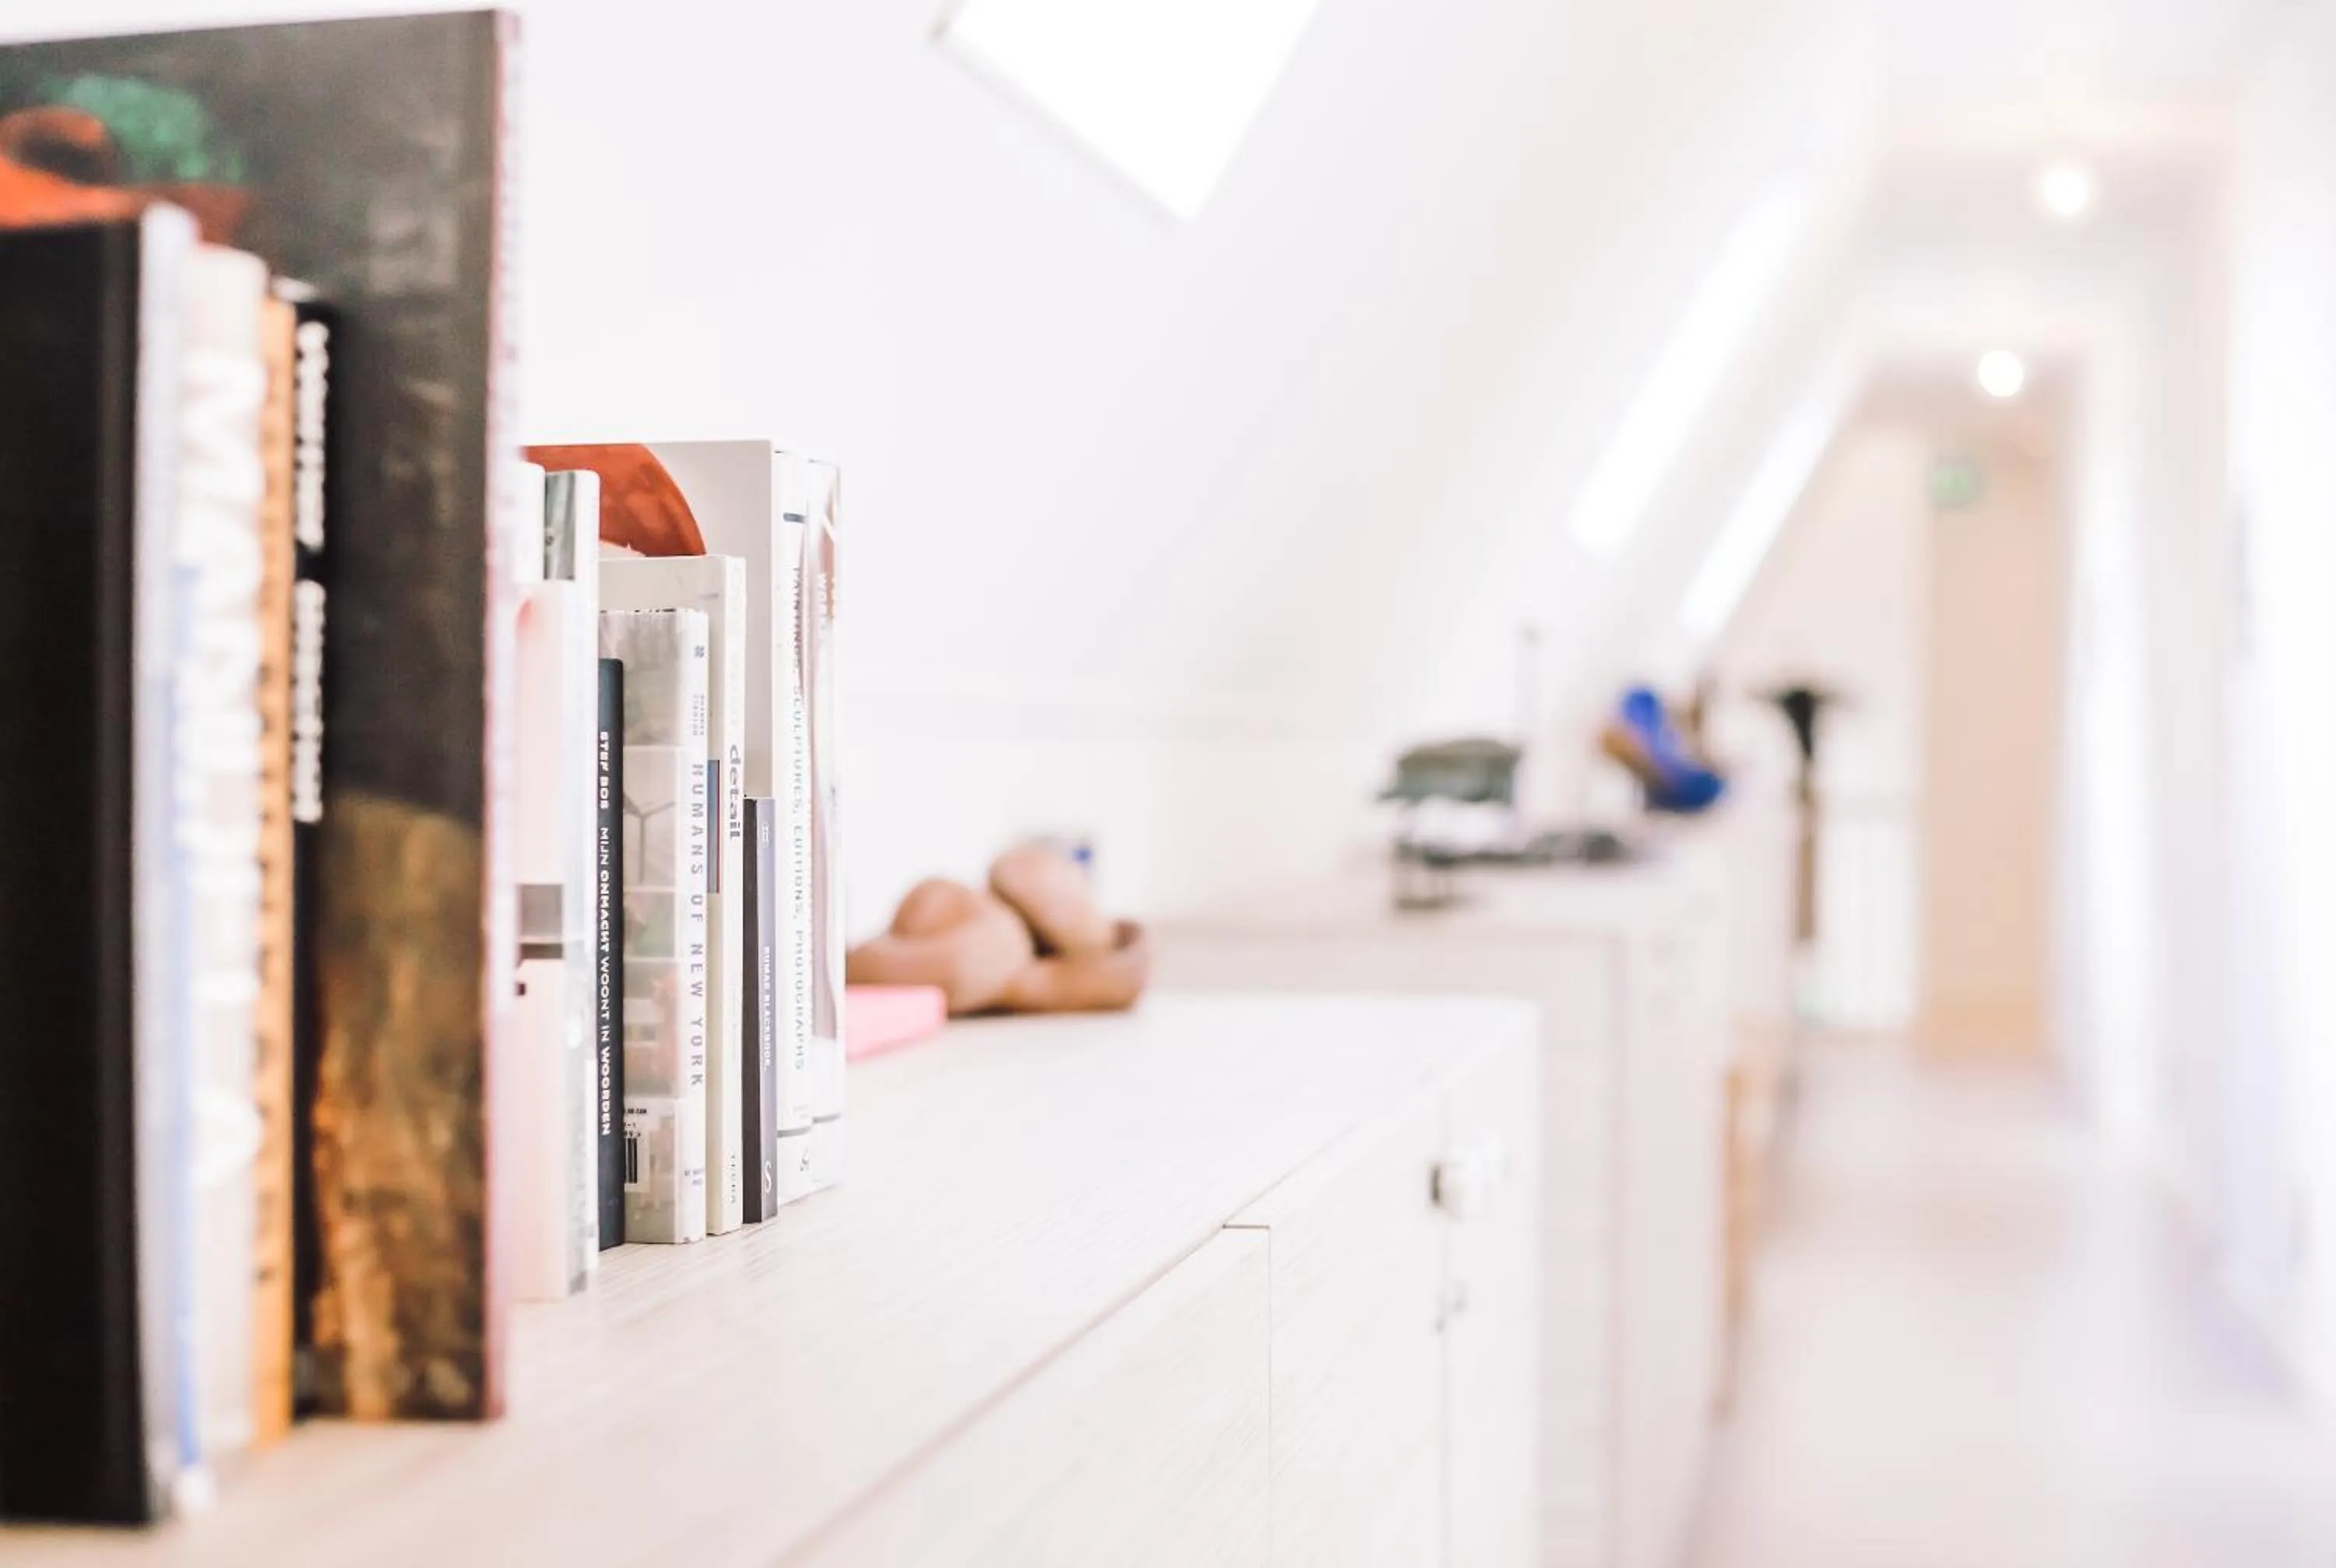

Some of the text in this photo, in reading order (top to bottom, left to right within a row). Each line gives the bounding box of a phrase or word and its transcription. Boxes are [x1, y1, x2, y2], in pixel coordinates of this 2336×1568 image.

[600, 776, 610, 810] BOS
[730, 745, 741, 839] detail
[600, 827, 610, 865] MIJN
[600, 870, 610, 952] ONMACHT
[691, 763, 704, 1085] HUMANS OF NEW YORK
[600, 956, 610, 1020] WOONT
[601, 1025, 610, 1042] IN
[601, 1046, 610, 1135] WOORDEN
